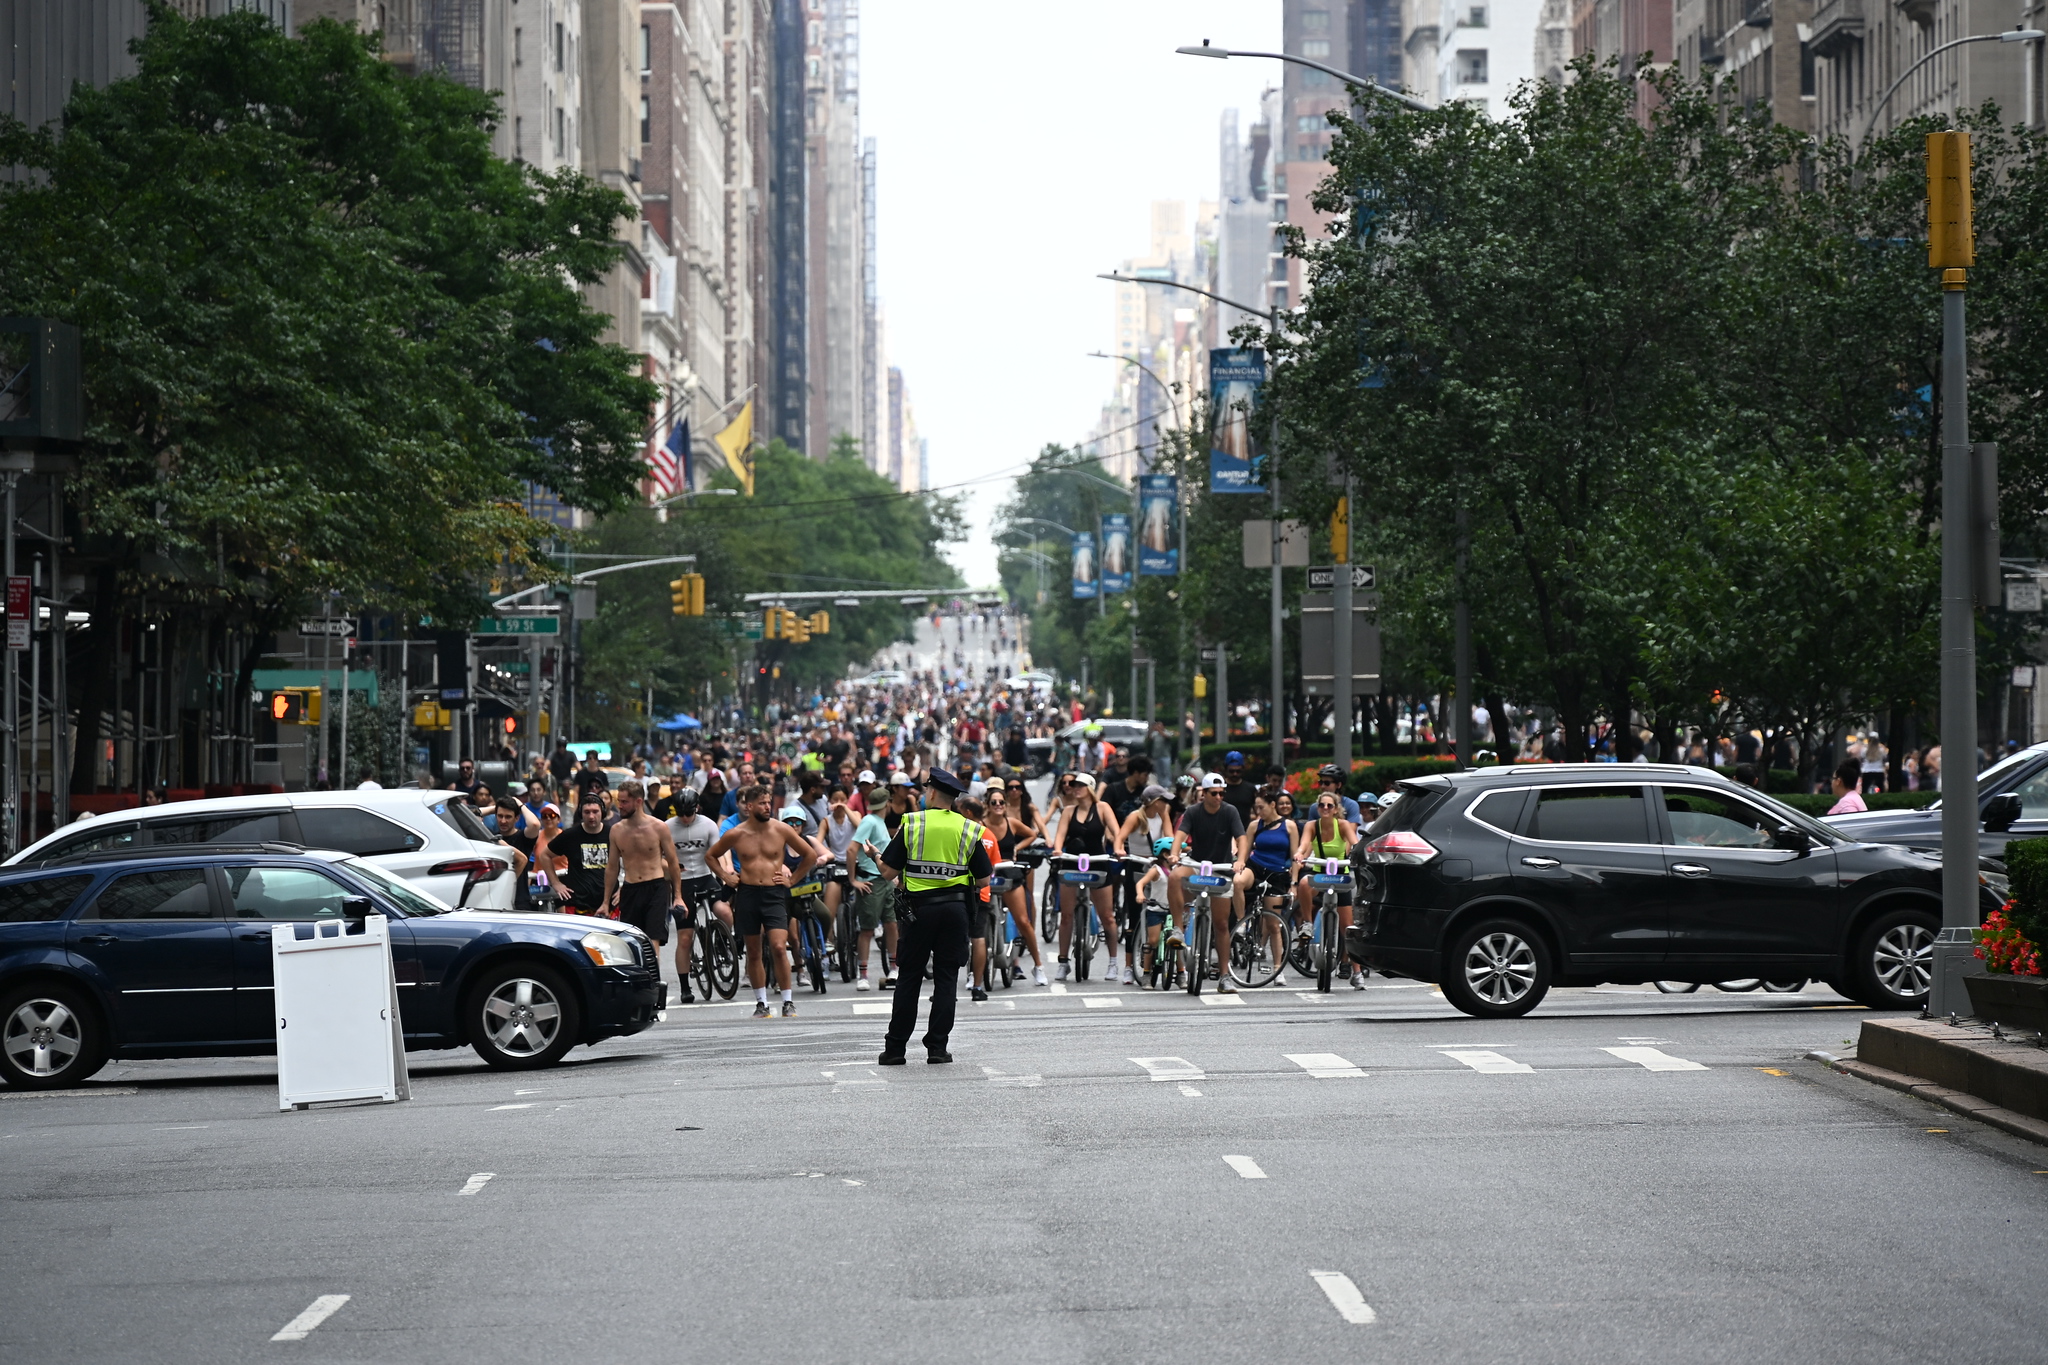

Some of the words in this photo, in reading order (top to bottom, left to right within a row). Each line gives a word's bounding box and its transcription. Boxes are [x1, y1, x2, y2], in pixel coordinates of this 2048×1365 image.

[1213, 367, 1261, 375] FINANCIAL
[496, 621, 502, 632] E
[506, 620, 519, 632] 59
[523, 620, 535, 632] St
[920, 865, 957, 877] NYPD
